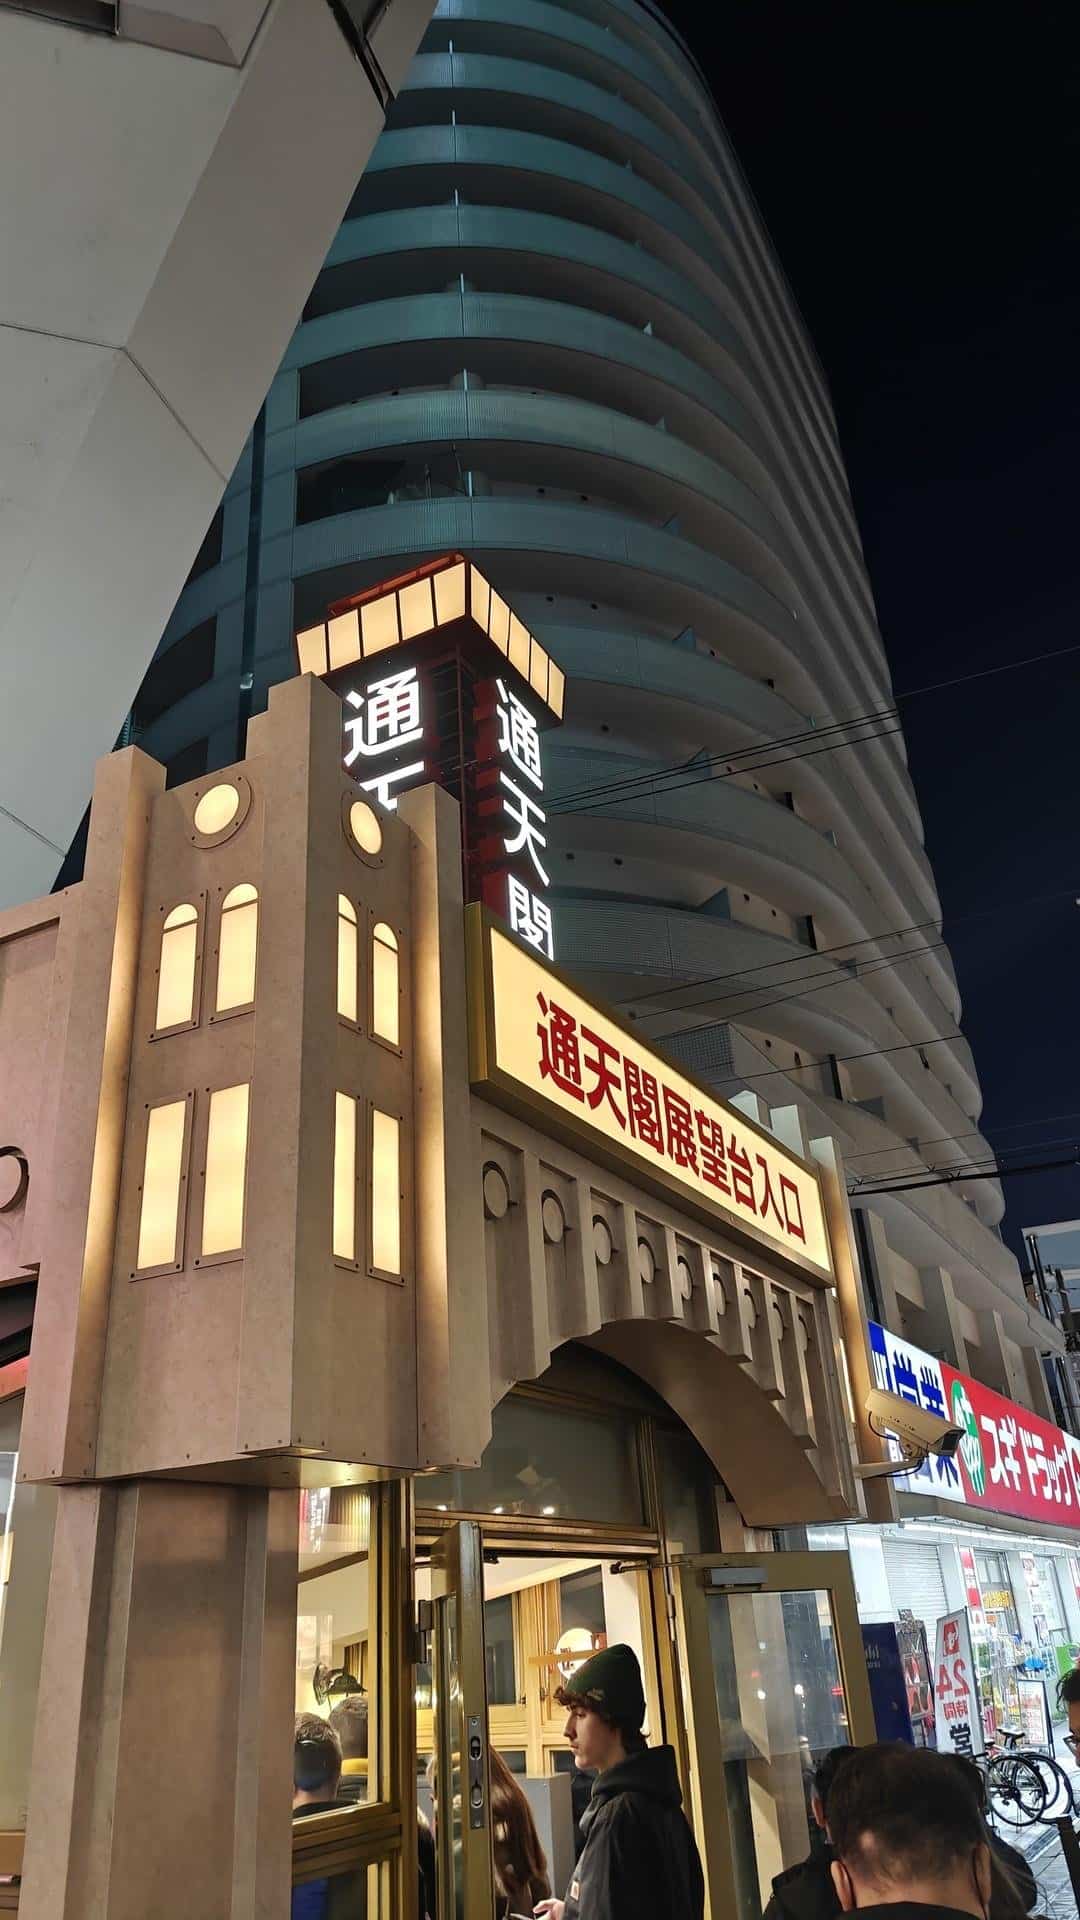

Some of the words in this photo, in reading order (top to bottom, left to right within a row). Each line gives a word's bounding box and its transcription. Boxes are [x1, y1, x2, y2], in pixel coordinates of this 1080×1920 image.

[536, 991, 807, 1244] 通天閣展望台入口
[980, 1414, 1072, 1507] スギドラッグ
